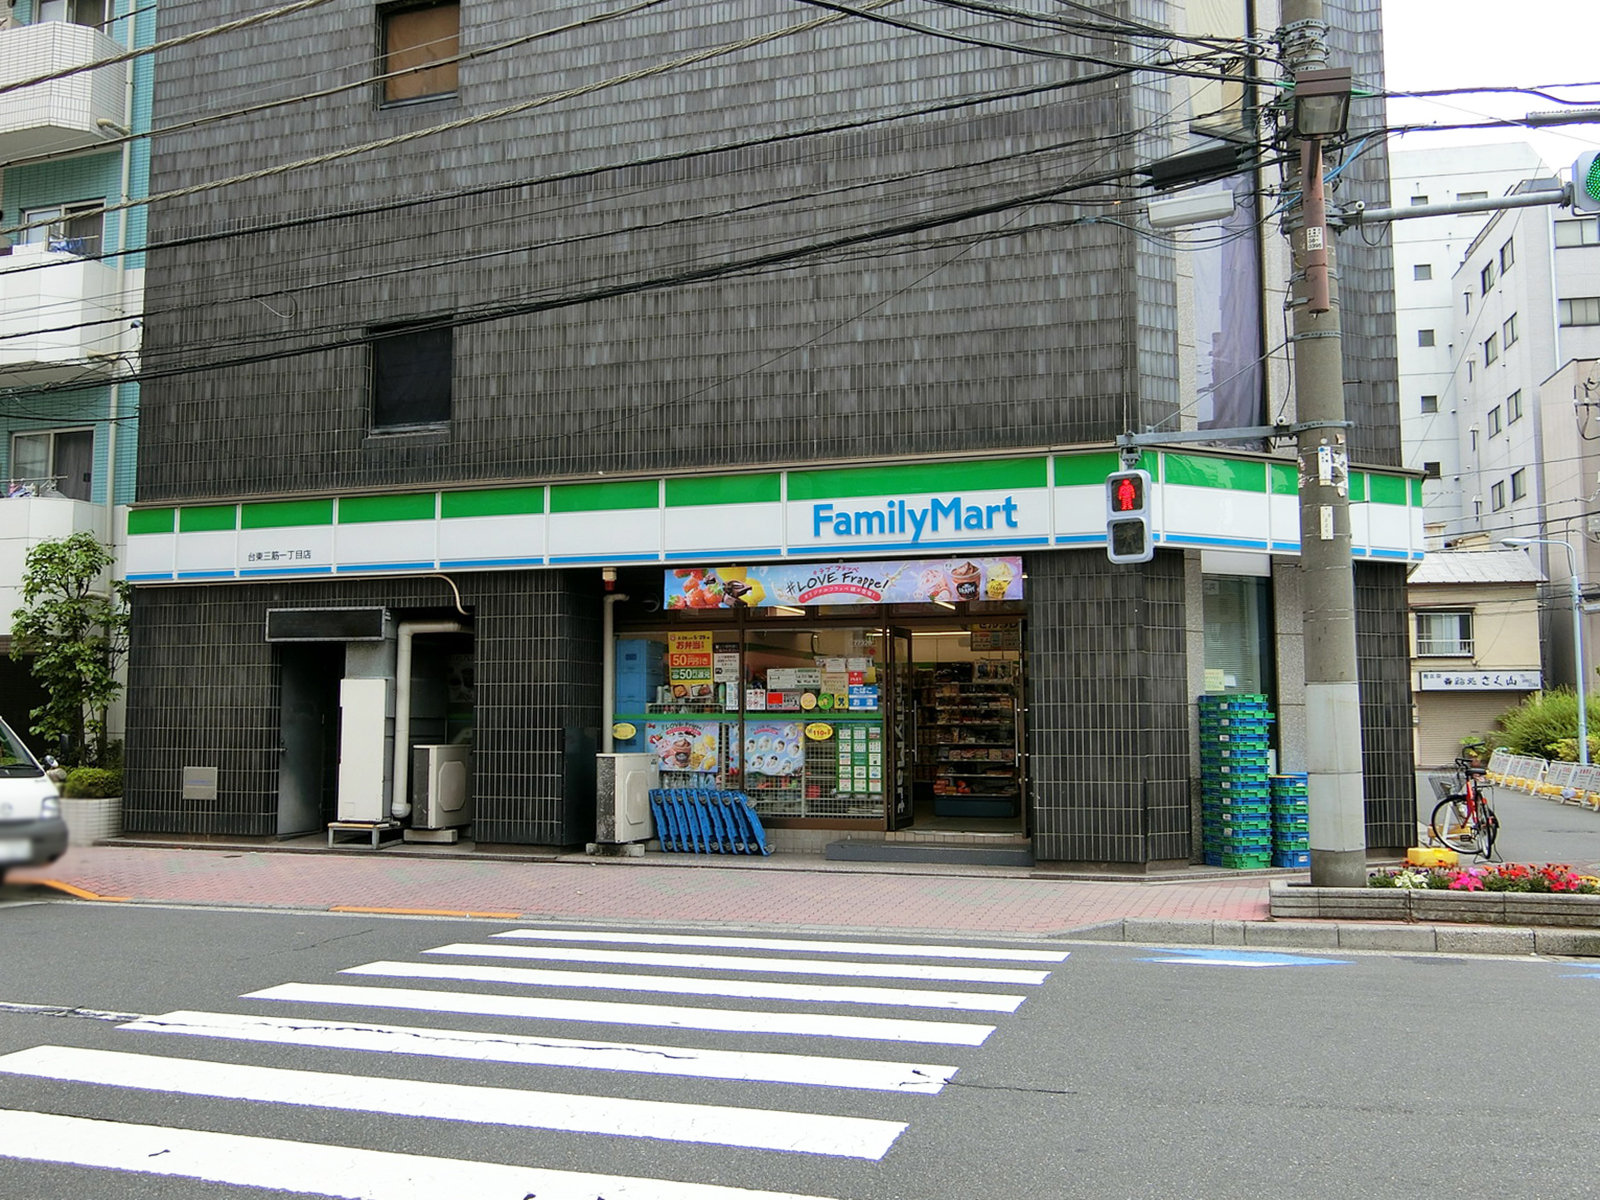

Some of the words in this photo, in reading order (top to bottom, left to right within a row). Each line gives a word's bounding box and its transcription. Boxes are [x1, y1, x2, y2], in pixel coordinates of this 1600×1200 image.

[813, 496, 1018, 542] FamilyMart
[248, 550, 311, 561] 台東三筋一丁目店
[786, 572, 838, 596] #LOVE
[841, 571, 890, 593] Frappe!
